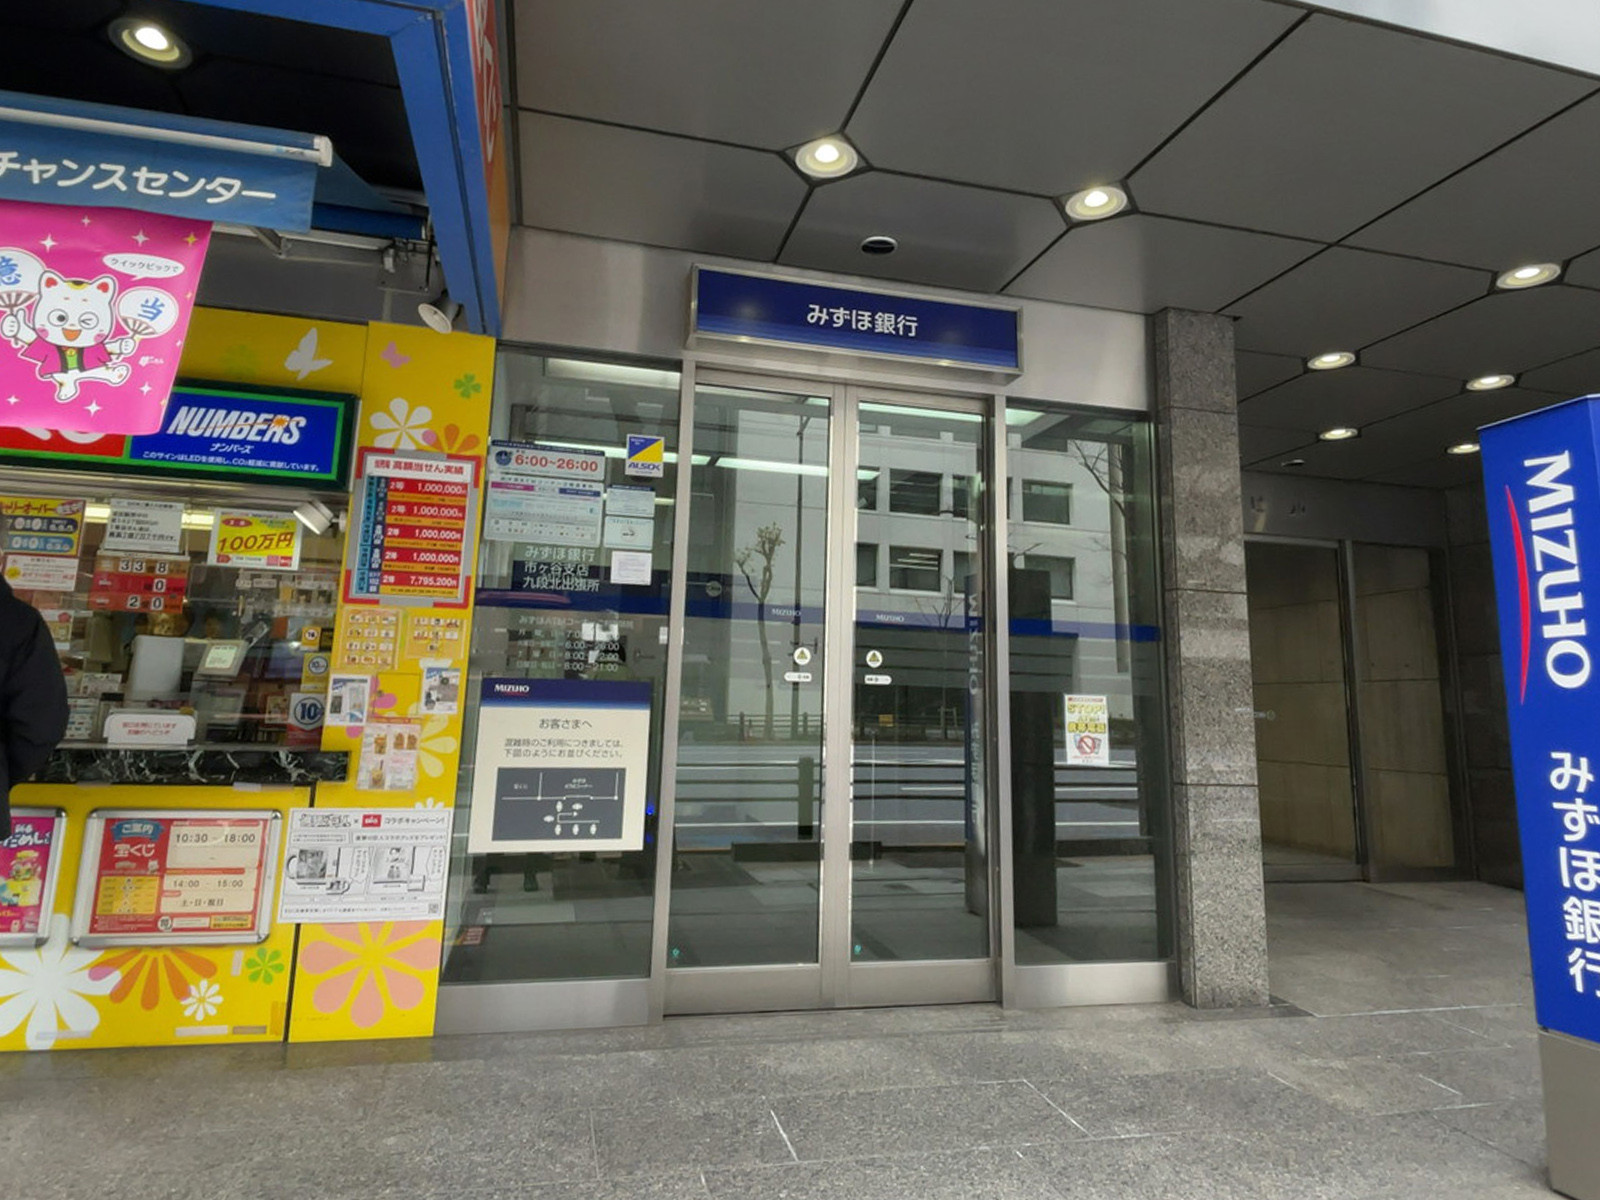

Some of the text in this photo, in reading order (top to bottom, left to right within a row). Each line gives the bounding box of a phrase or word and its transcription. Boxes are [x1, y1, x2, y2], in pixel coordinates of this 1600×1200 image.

[0, 151, 277, 204] チャンスセンター
[138, 297, 165, 322] 当
[807, 304, 918, 337] みずほ銀行
[167, 405, 307, 445] NUMBERS
[209, 442, 255, 455] ナンバーズ
[628, 461, 661, 472] ALSOK
[219, 531, 296, 553] 100万円
[524, 545, 596, 562] みずほ銀行
[1523, 449, 1591, 690] MIZUHO
[522, 575, 600, 592] 九段北出張所
[771, 608, 802, 617] MIZUHO
[875, 613, 905, 623] MIZUHO
[494, 682, 530, 694] MIZUHO
[539, 717, 593, 730] お客さまへ
[175, 832, 256, 845] 10:30 18:00
[113, 843, 156, 859] 宝くじ
[1550, 752, 1600, 998] みずほ銀行
[172, 878, 244, 889] 14:00 15:00
